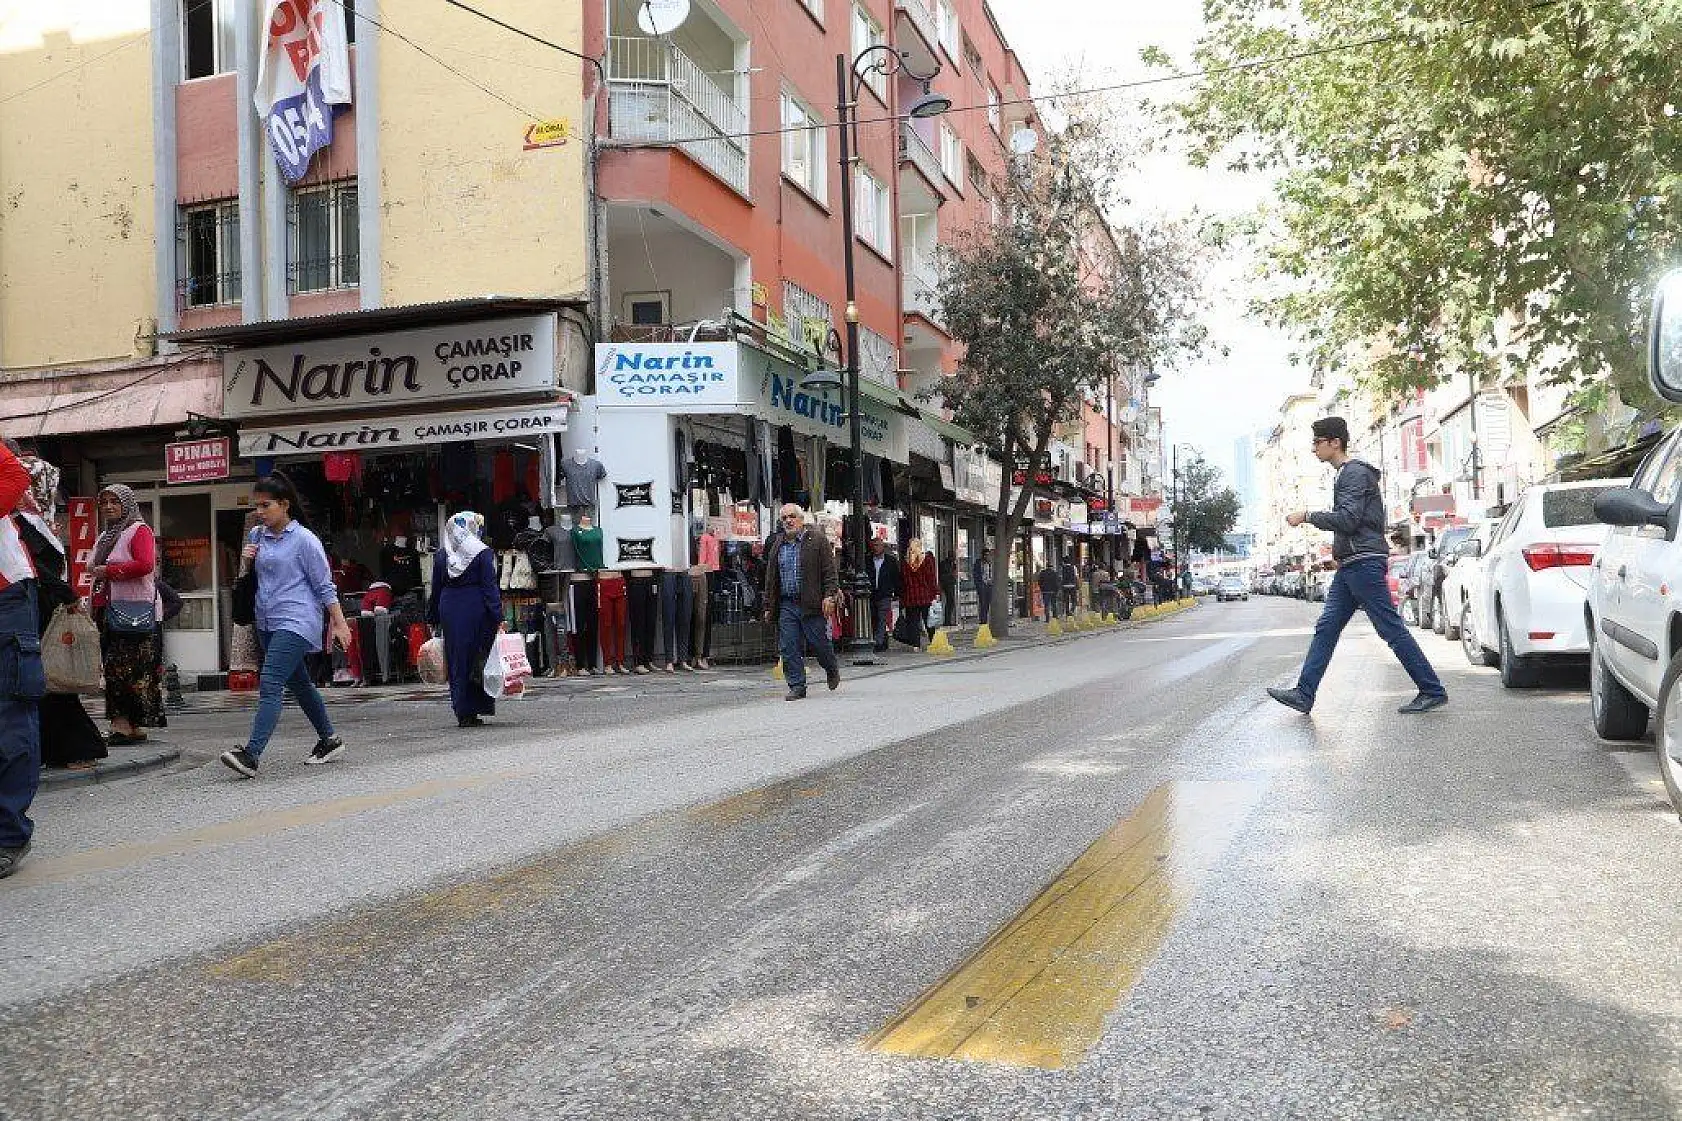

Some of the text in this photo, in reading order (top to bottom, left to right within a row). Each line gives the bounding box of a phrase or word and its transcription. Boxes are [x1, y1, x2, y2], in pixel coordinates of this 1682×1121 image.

[434, 333, 534, 361] ÇAMAŞIR
[615, 351, 714, 371] Narin
[250, 347, 423, 406] Narin
[447, 360, 522, 389] ÇORAP
[610, 372, 724, 384] ÇAMAŞIR
[619, 385, 705, 397] ÇORAP
[771, 372, 846, 428] Narin
[267, 415, 552, 450] Narin ÇAMAŞIR ÇORAP
